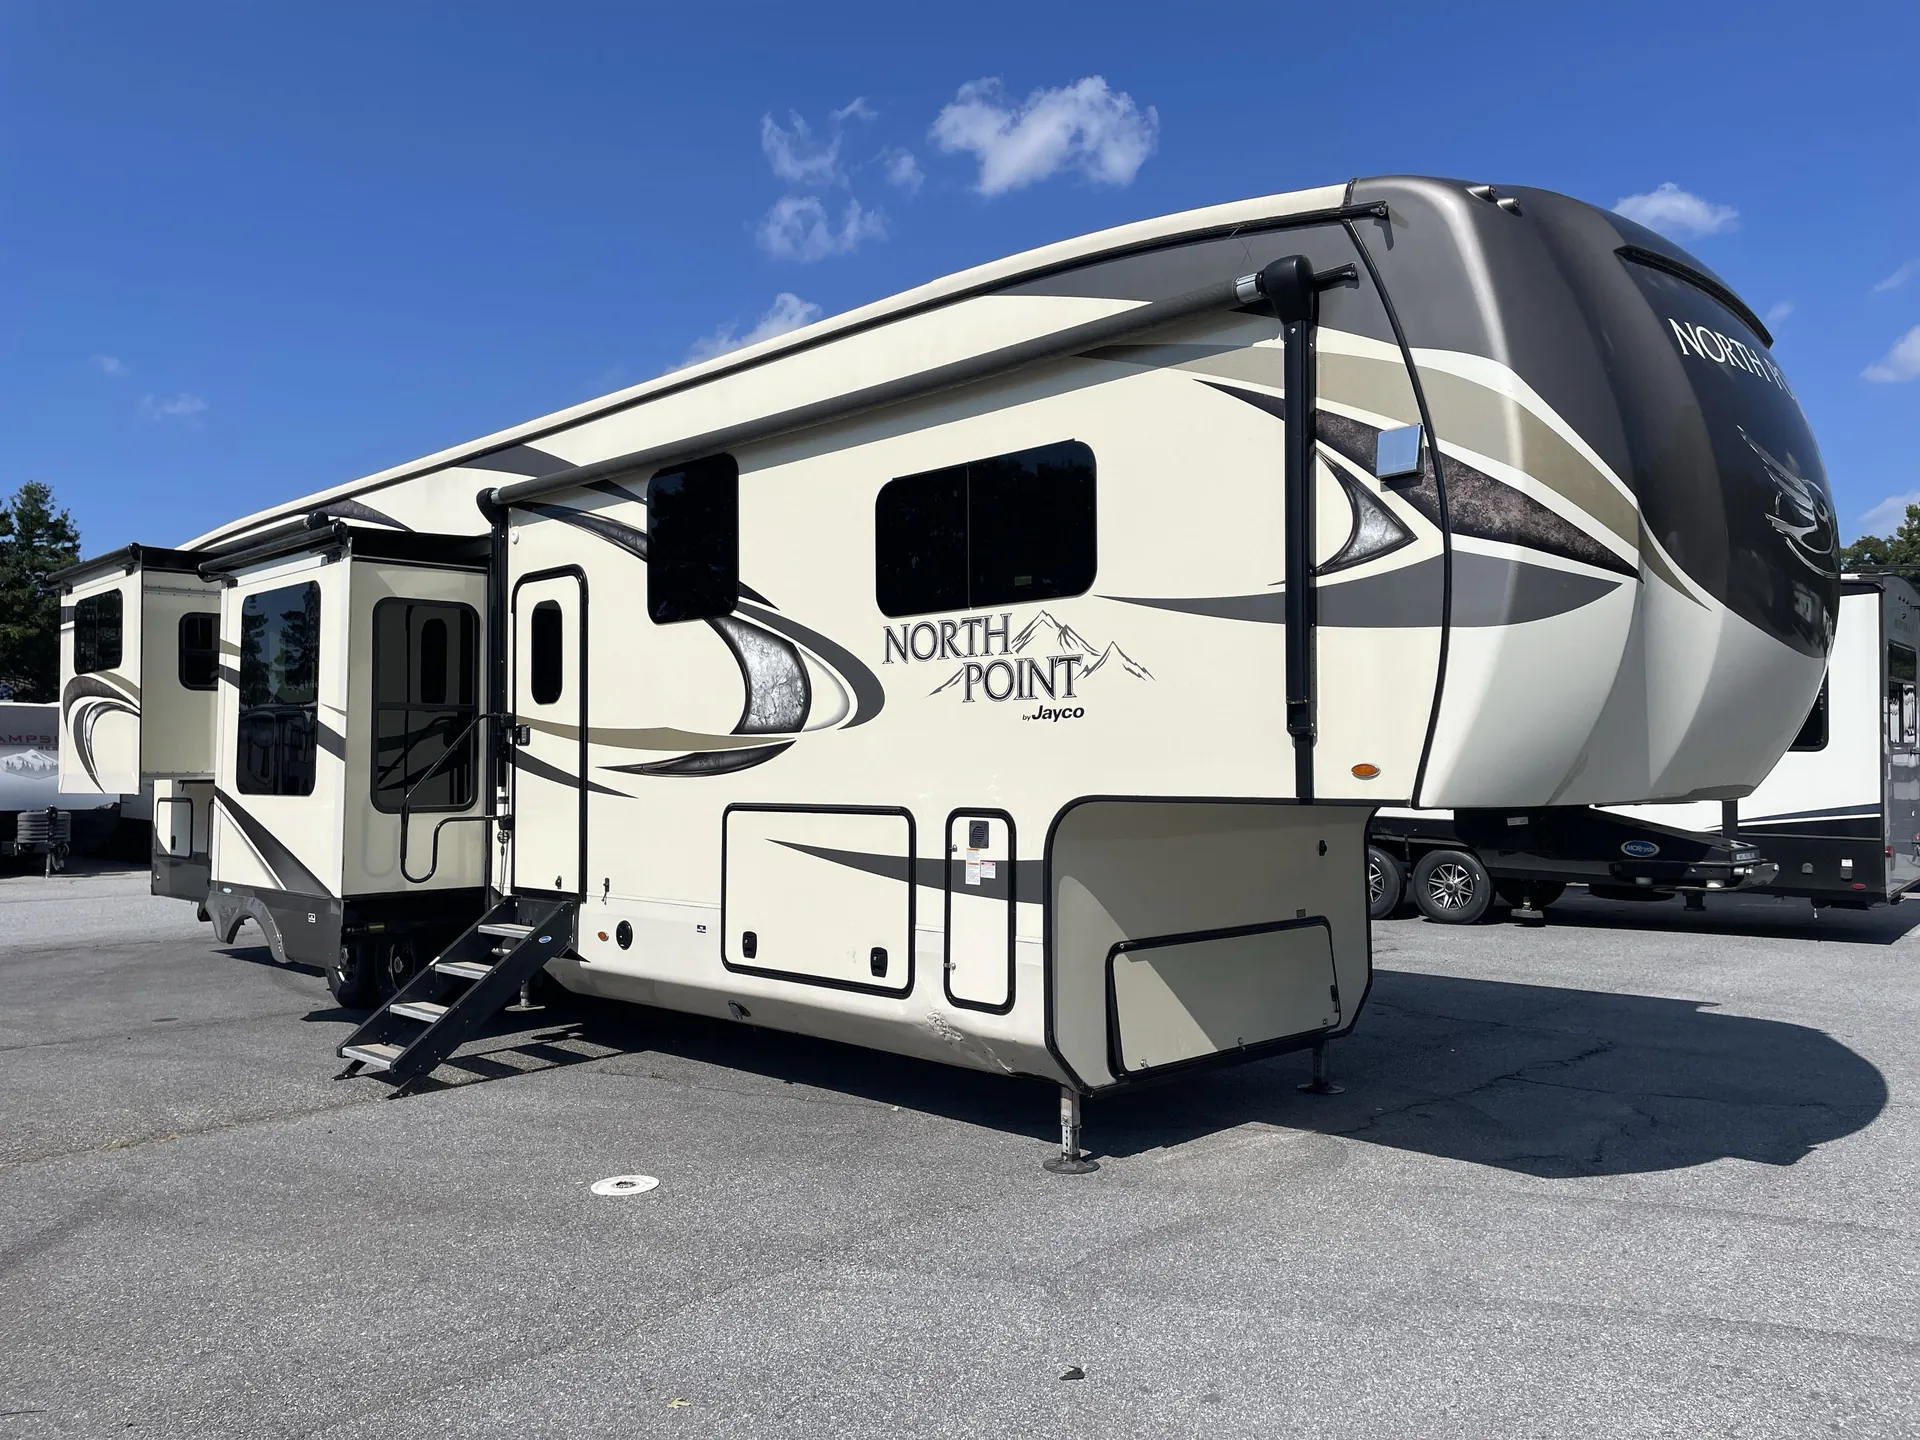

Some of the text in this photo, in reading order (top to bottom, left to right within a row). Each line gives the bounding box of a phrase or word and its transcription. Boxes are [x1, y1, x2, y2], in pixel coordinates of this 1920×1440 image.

[1667, 317, 1772, 383] NORTH
[882, 612, 1013, 665] NORTH
[962, 654, 1084, 703] POINT
[1022, 704, 1085, 722] by Jayco
